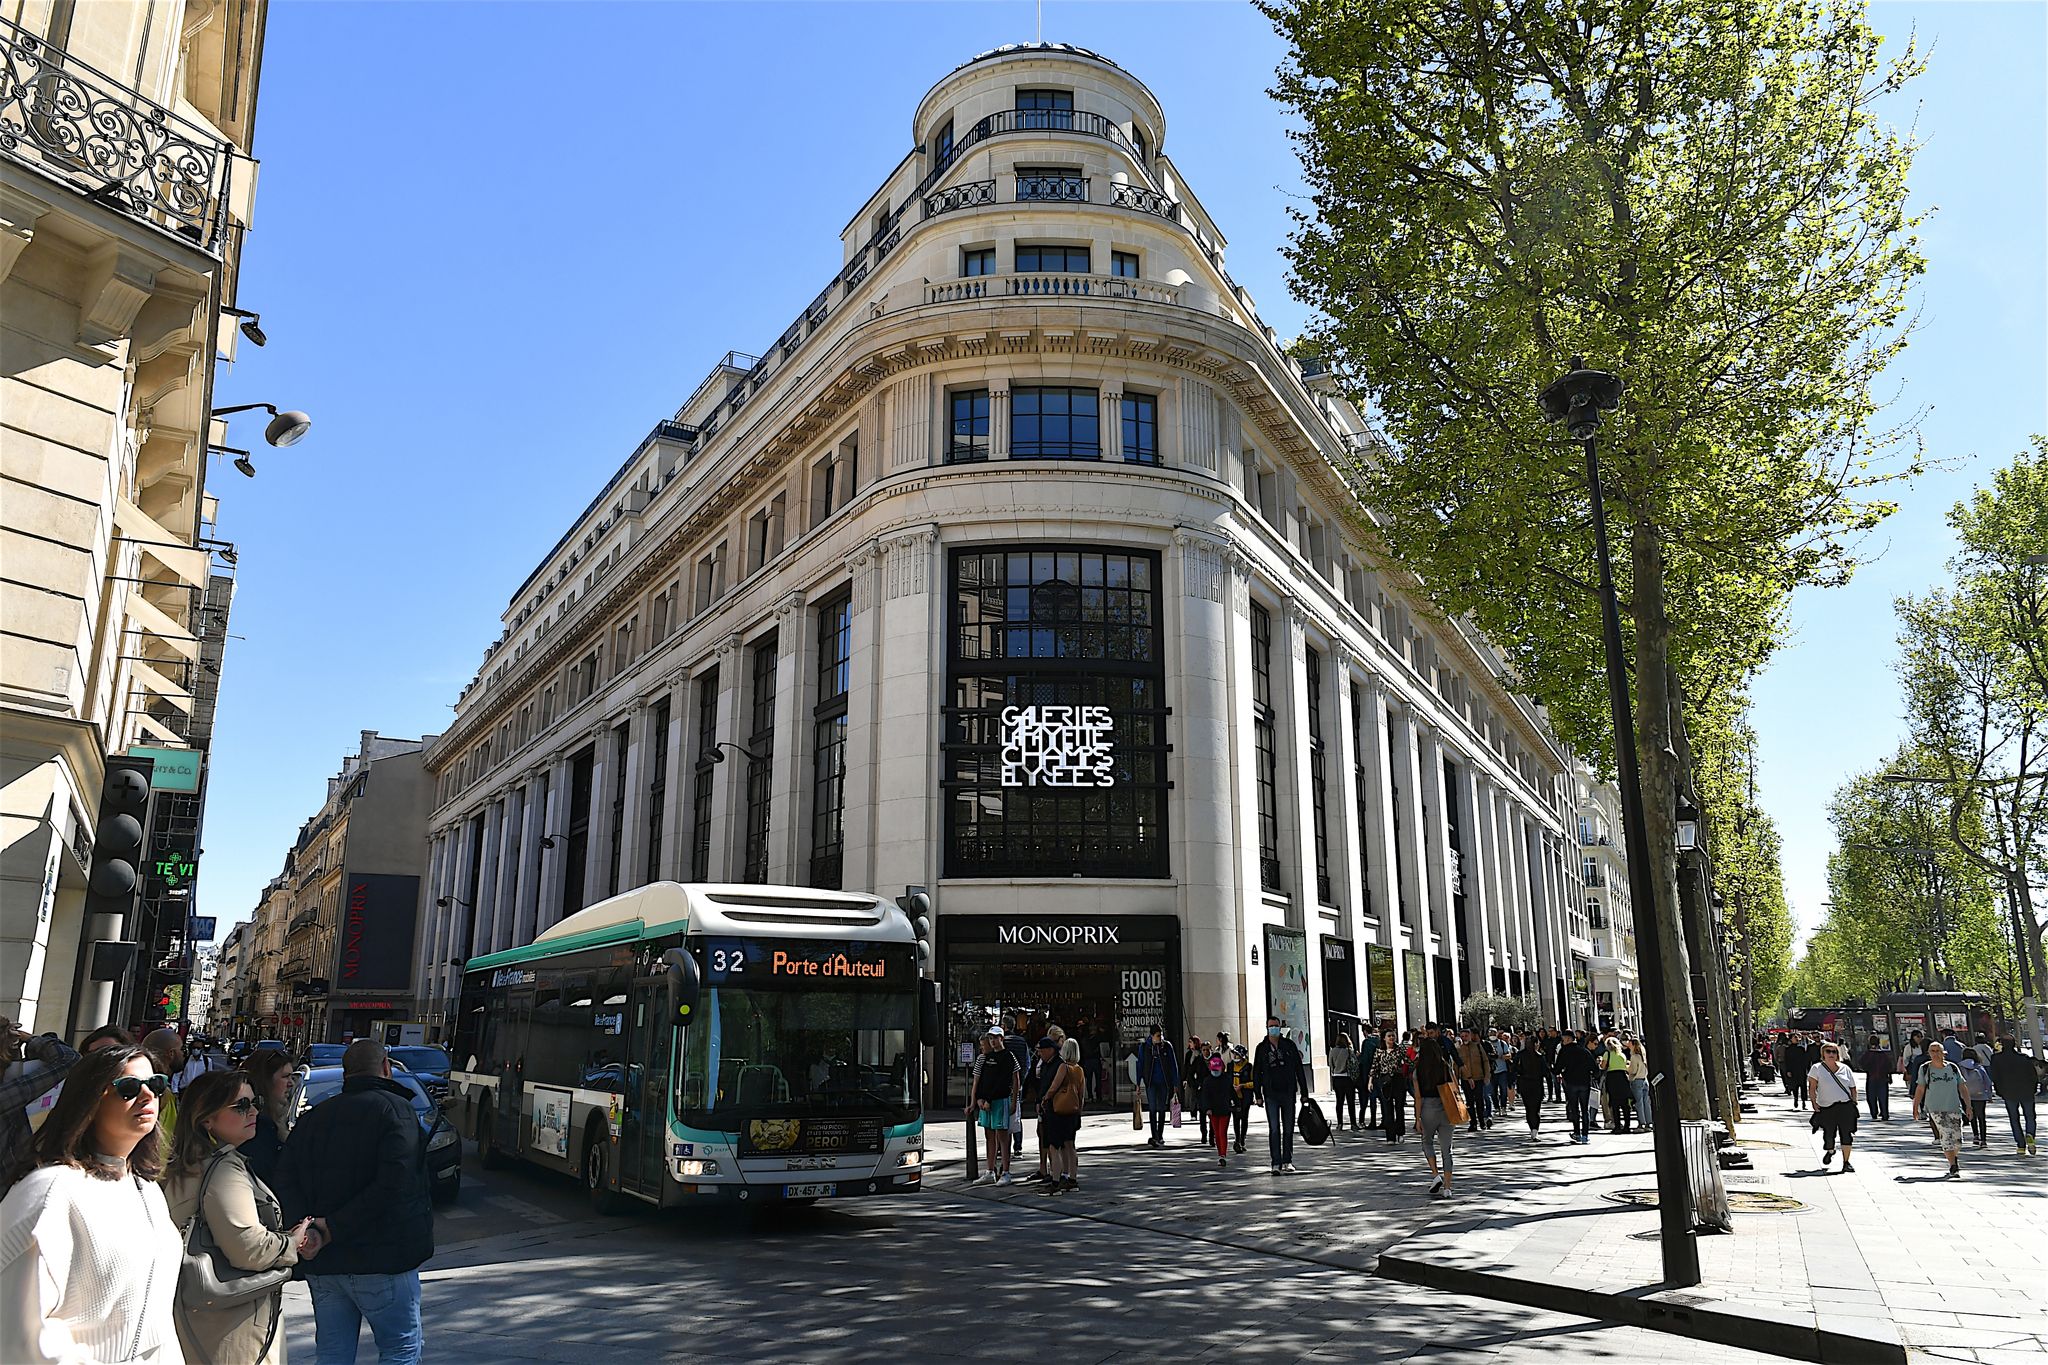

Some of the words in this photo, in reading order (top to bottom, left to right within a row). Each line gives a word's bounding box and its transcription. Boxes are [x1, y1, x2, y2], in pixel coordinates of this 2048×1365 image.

[1001, 705, 1114, 727] GALERIES
[1001, 723, 1114, 747] LAFAYETTE
[1001, 745, 1115, 768] CHAMPS
[344, 882, 369, 980] MONOPRIX
[998, 925, 1120, 945] MONOPRIX
[713, 950, 744, 972] 32
[772, 951, 818, 975] Porte
[822, 953, 884, 977] d'Auteuil
[1121, 970, 1162, 990] FOOD
[348, 1001, 392, 1009] MONOPRIX
[1122, 991, 1162, 1007] STORE
[788, 1185, 830, 1197] DX-457-JR
